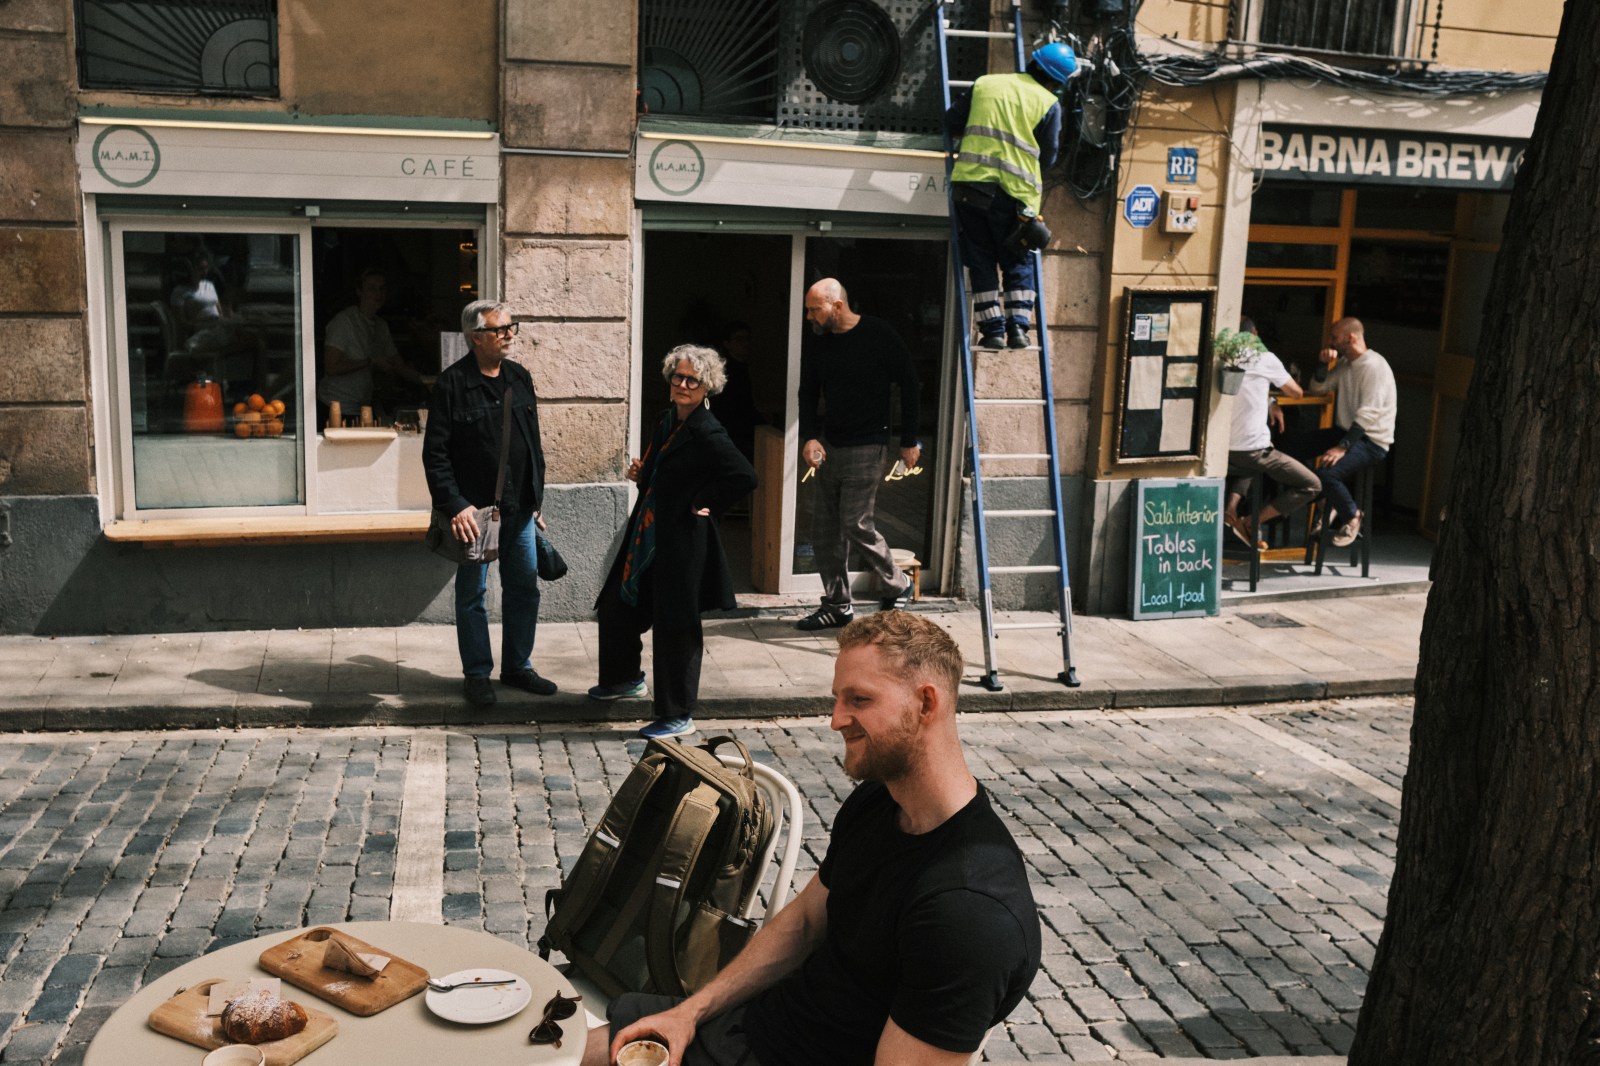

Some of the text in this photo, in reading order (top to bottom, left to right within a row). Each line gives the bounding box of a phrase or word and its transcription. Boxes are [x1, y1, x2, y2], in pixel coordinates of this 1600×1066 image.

[100, 150, 154, 161] M.A.M.I.
[401, 156, 474, 177] CAFÉ
[1170, 156, 1195, 175] RB
[1257, 131, 1512, 182] BARNA BREW
[1131, 197, 1155, 212] ADT
[884, 460, 923, 481] Lve
[1143, 500, 1218, 526] Sala interior
[1142, 531, 1196, 555] Tables
[1158, 549, 1213, 574] in back
[1142, 582, 1205, 608] Local food
